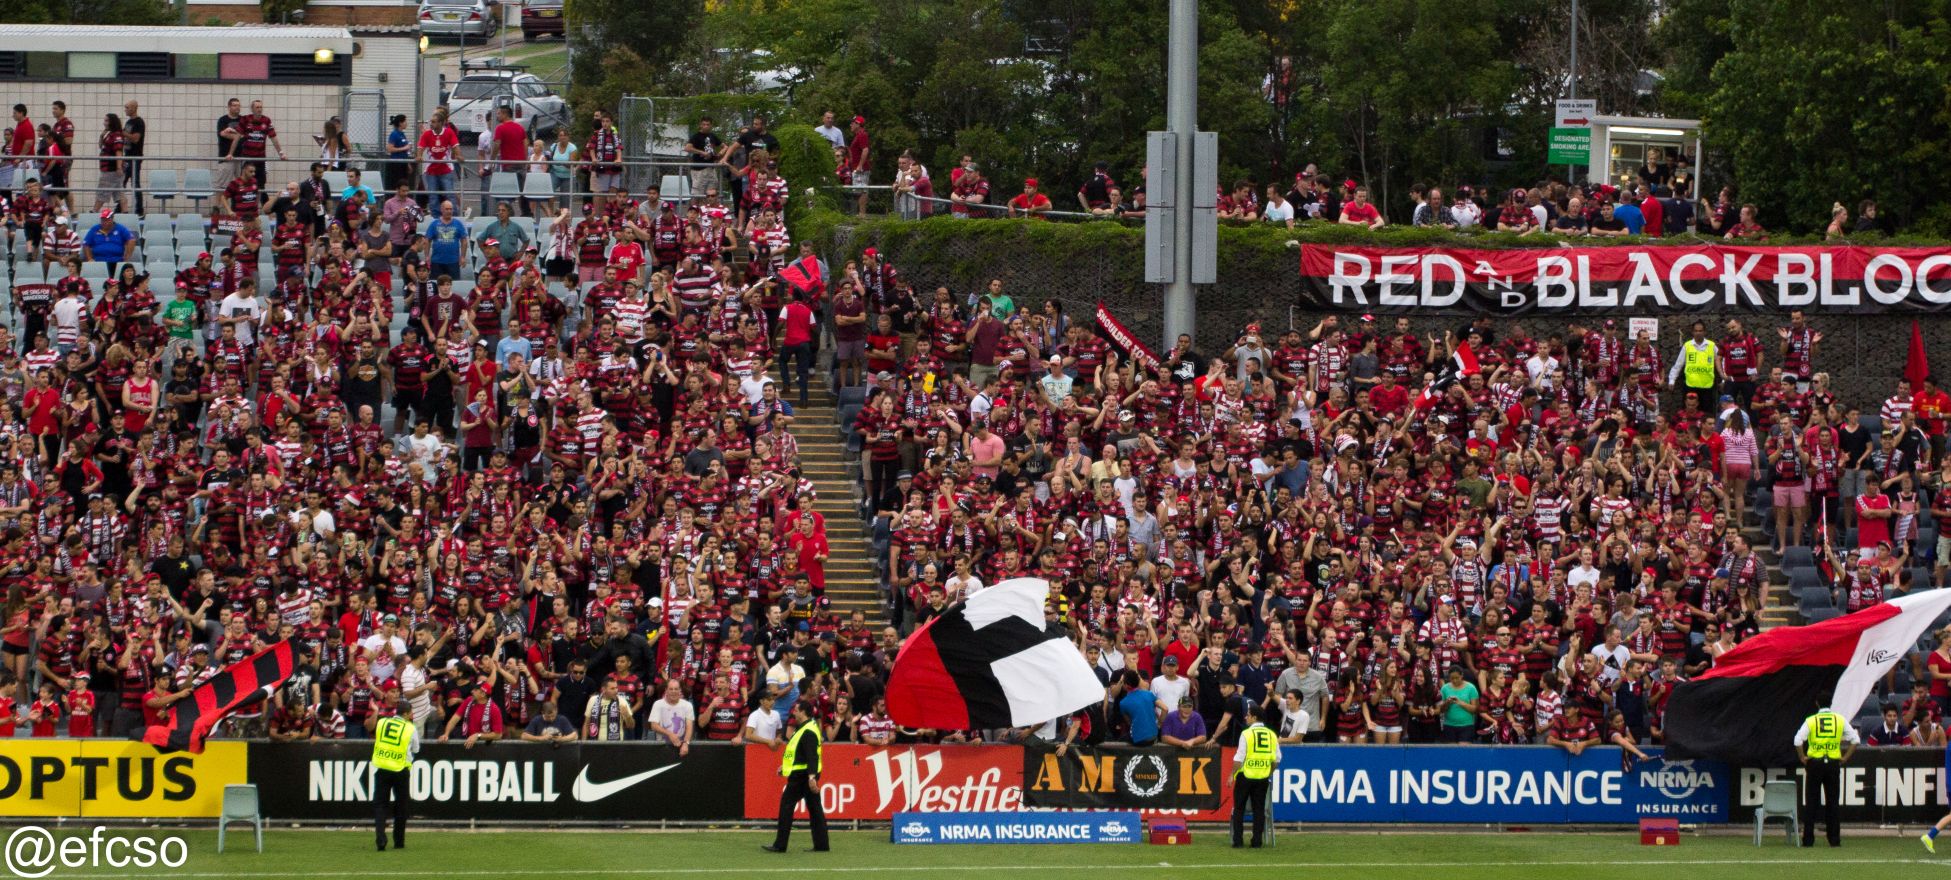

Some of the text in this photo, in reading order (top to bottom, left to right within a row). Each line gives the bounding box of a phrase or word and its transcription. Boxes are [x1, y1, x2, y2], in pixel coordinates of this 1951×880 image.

[1328, 252, 1466, 307] RED
[1533, 253, 1765, 308] BLACK
[1097, 308, 1133, 350] SHOULDER
[384, 722, 400, 740] E
[1820, 718, 1833, 733] E
[1257, 732, 1268, 748] E
[376, 750, 403, 760] ROUP
[389, 760, 561, 802] OOTBALL
[1389, 769, 1624, 805] INSURANCE
[1640, 771, 1714, 788] NRMA
[1636, 803, 1718, 814] INSURANCE
[940, 824, 1091, 840] NRMA INSURANCE
